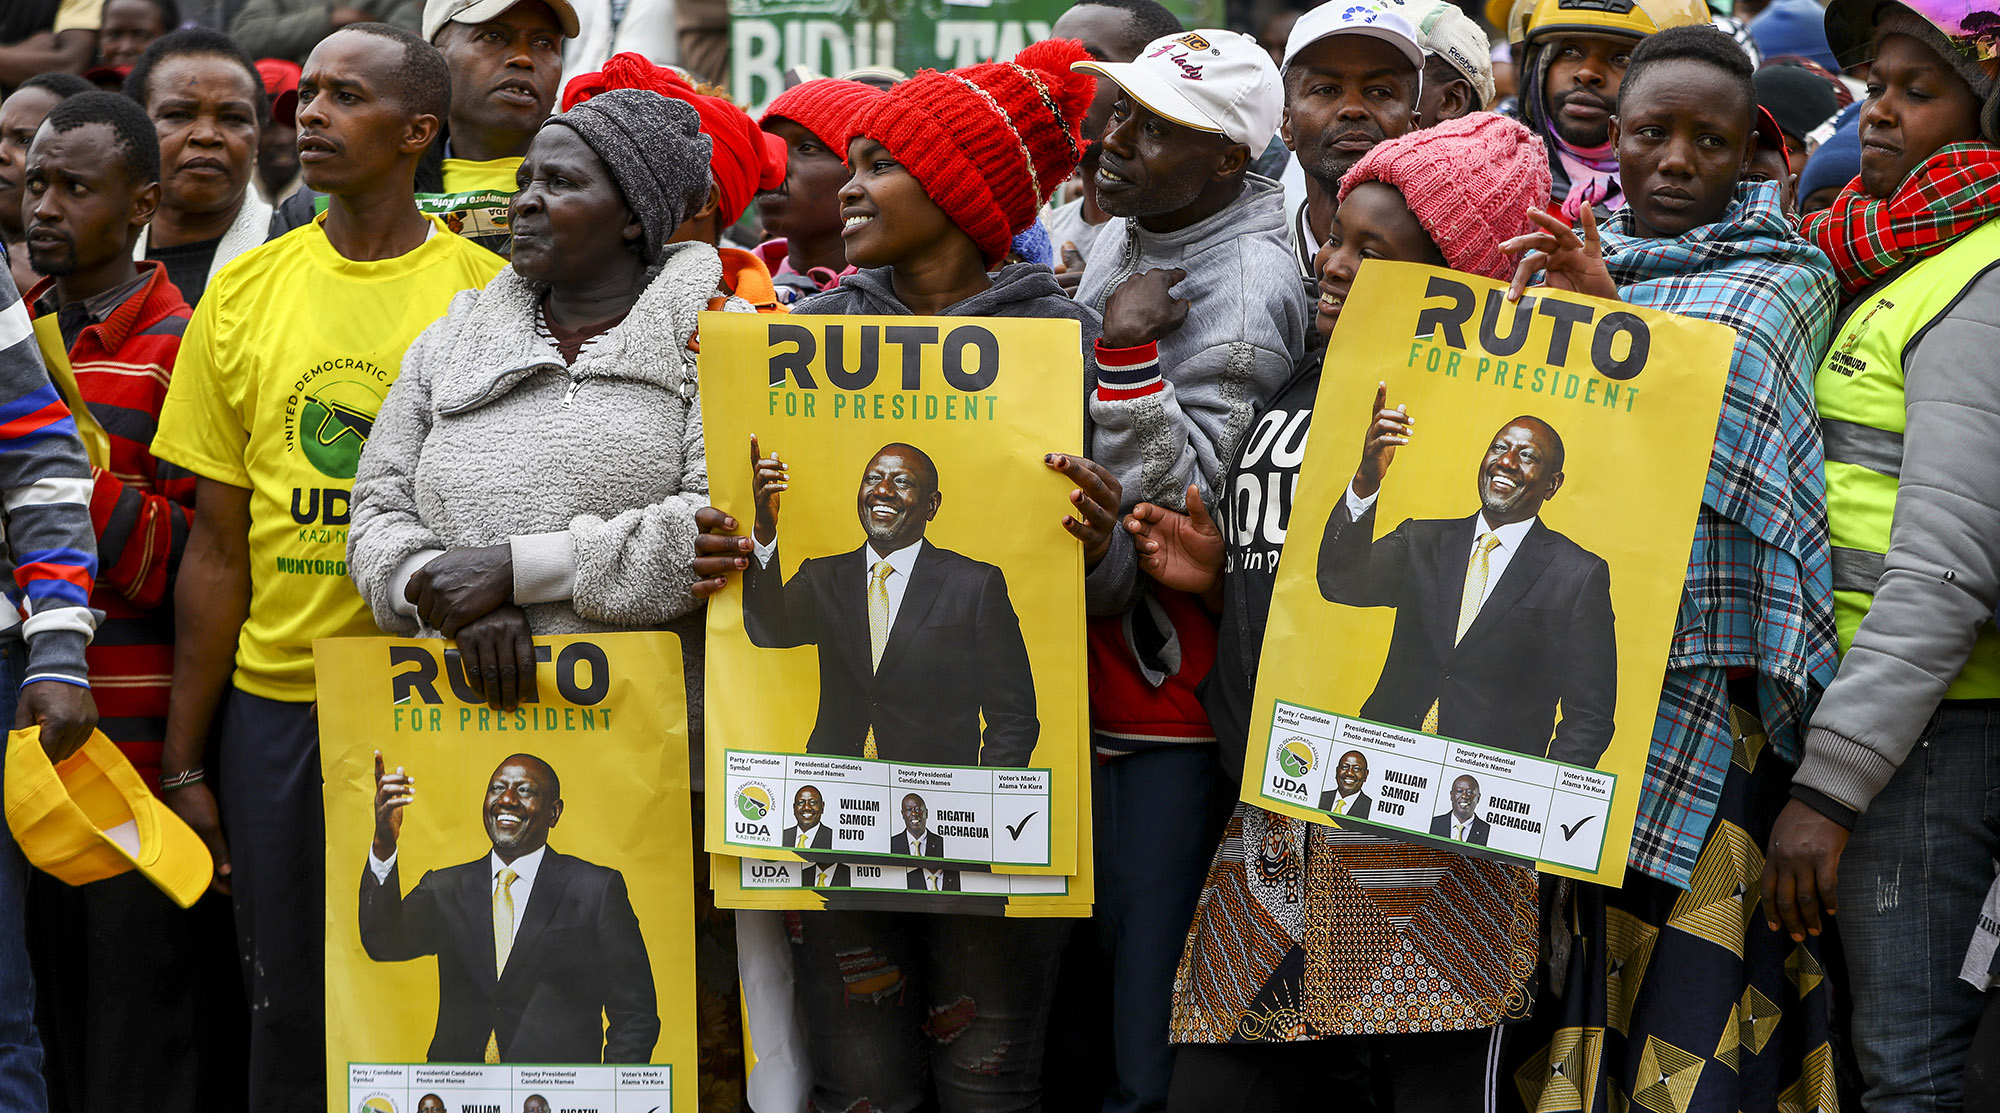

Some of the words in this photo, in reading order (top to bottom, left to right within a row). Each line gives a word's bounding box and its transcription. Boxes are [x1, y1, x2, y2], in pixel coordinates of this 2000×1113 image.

[1448, 46, 1478, 77] Reebok
[1414, 276, 1650, 381] RUTO
[768, 324, 999, 392] RUTO
[1408, 343, 1461, 377] FOR
[1476, 357, 1639, 412] PRESIDENT
[284, 395, 298, 453] UNITED
[295, 358, 387, 392] DEMOCRATIC
[769, 391, 816, 417] FOR
[834, 394, 998, 421] PRESIDENT
[291, 488, 351, 525] UD
[299, 529, 331, 543] KAZI
[277, 556, 347, 577] MUNYORO
[394, 708, 441, 732] FOR
[460, 707, 612, 732] PRESIDENT
[1278, 716, 1300, 727] Symbol
[1279, 708, 1295, 717] Party
[1300, 713, 1331, 726] Candidate
[1343, 732, 1361, 741] Photo
[1362, 736, 1374, 744] and
[1375, 739, 1396, 749] Names
[1345, 724, 1382, 737] Presidential
[1382, 732, 1416, 745] Candidate's
[729, 756, 745, 765] Party
[750, 758, 780, 766] Candidate
[1455, 756, 1489, 769] Candidate's
[1490, 763, 1512, 774] Names
[1456, 748, 1478, 759] Deputy
[1479, 753, 1516, 766] Presidential
[831, 763, 862, 771] Candidate's
[898, 769, 917, 777] Deputy
[898, 777, 929, 785] Candidate's
[1273, 776, 1308, 796] UDA
[1385, 769, 1428, 790] WILLIAM
[1563, 771, 1585, 781] Voter's
[1585, 776, 1602, 785] Mark
[1381, 785, 1420, 804] SAMOEI
[1561, 779, 1581, 789] Alama
[1591, 786, 1606, 795] Kura
[840, 799, 880, 812] WILLIAM
[1378, 801, 1405, 816] RUTO
[1489, 796, 1530, 816] RIGATHI
[840, 814, 875, 826] SAMOEI
[937, 810, 975, 823] RIGATHI
[1486, 812, 1542, 834] GACHAGUA
[735, 822, 771, 836] UDA
[839, 829, 864, 841] RUTO
[937, 825, 989, 838] GACHAGUA
[752, 866, 789, 877] UDA
[857, 866, 881, 877] RUTO
[353, 1069, 368, 1077] Party
[462, 1105, 501, 1113] WILLIAM
